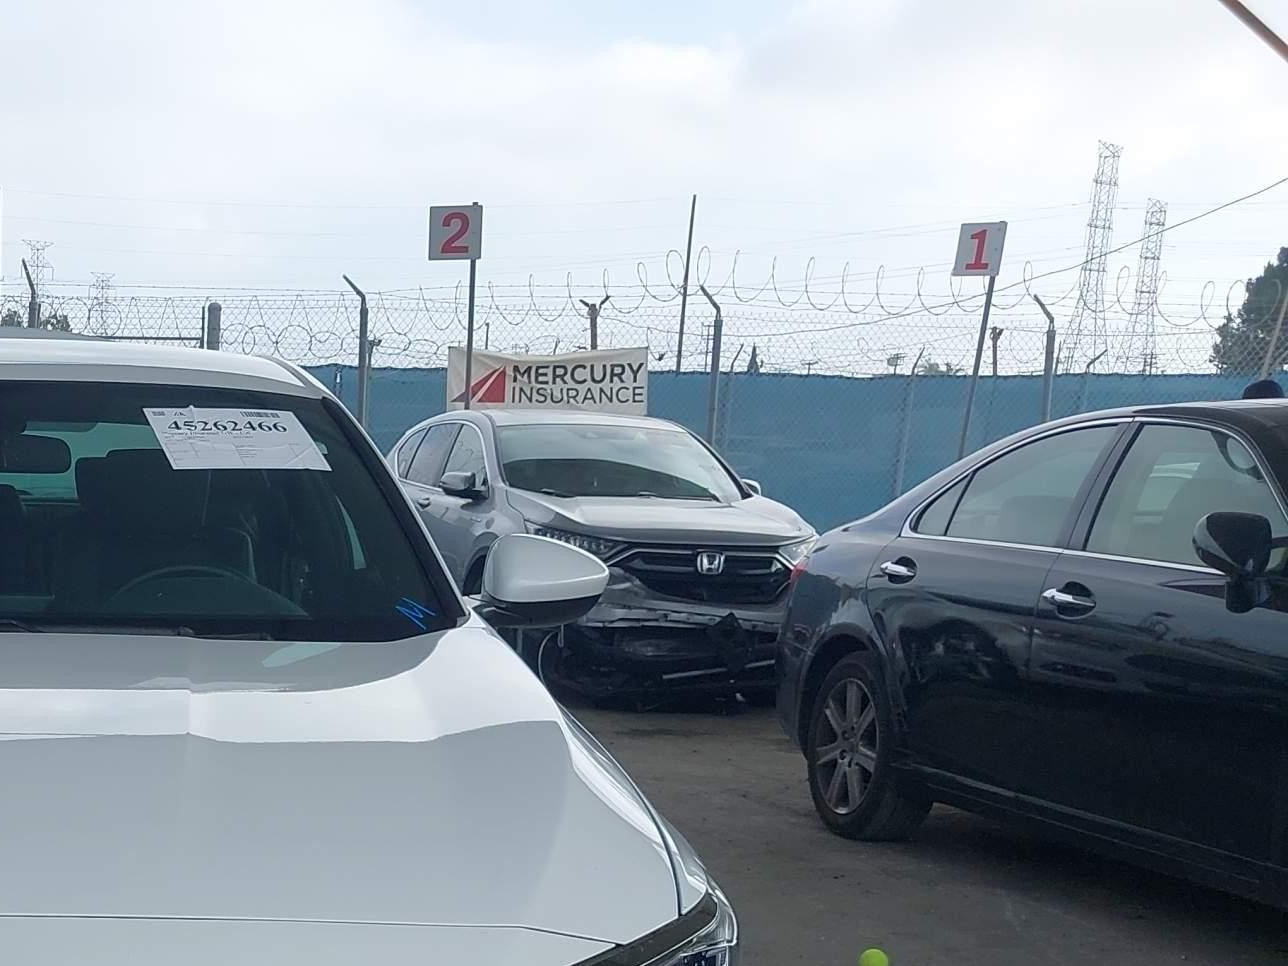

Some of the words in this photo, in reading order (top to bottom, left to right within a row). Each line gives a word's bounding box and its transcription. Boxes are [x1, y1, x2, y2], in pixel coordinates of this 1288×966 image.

[441, 212, 471, 254] 2
[964, 229, 990, 271] 1
[513, 362, 645, 385] MERCURY
[512, 386, 645, 405] INSURANCE
[167, 420, 287, 433] 45262466
